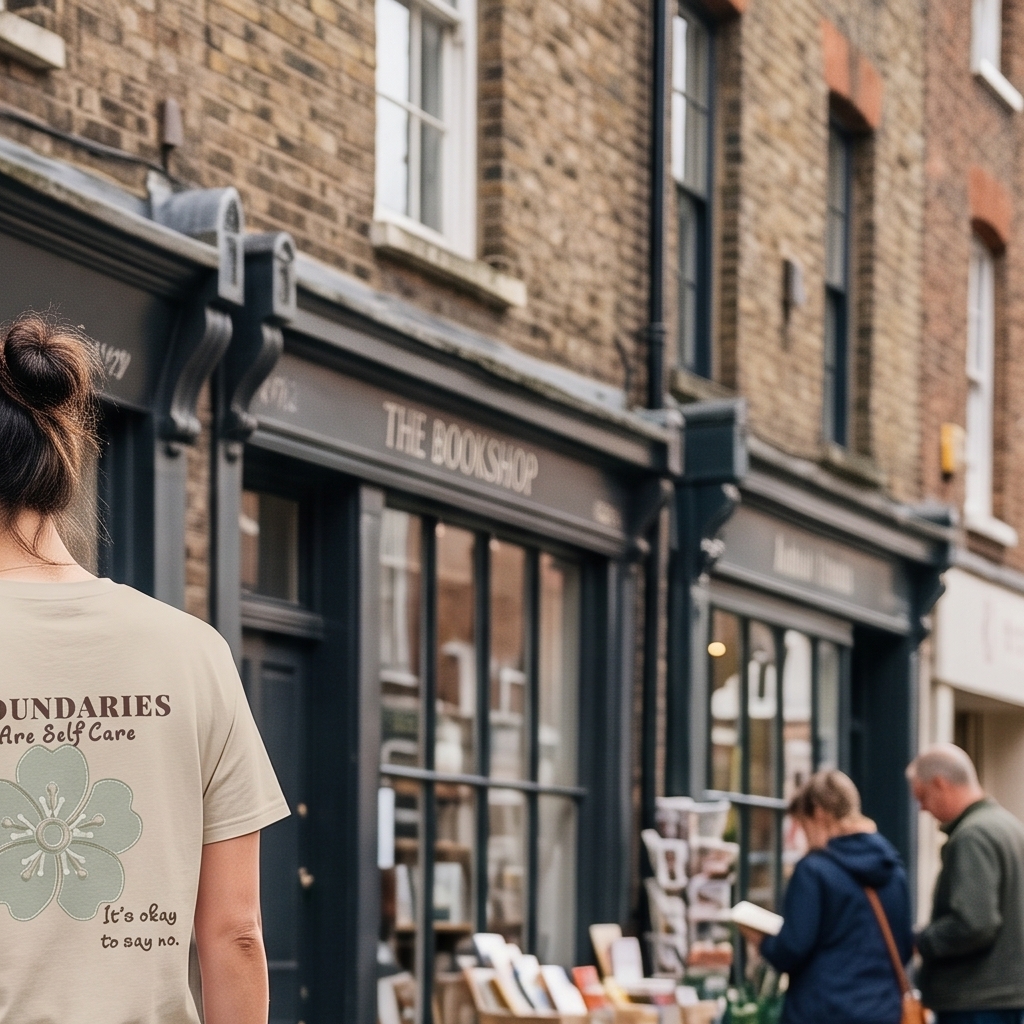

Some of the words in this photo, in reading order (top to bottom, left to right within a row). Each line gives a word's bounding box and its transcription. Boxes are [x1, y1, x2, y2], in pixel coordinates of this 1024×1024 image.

[383, 400, 428, 460] THE
[431, 418, 539, 497] BOOKSHOP
[42, 720, 86, 747] Self
[88, 721, 136, 742] Care
[102, 904, 135, 925] It's
[139, 902, 178, 926] okay
[100, 933, 119, 949] to
[123, 936, 153, 952] say
[158, 935, 180, 948] no.
